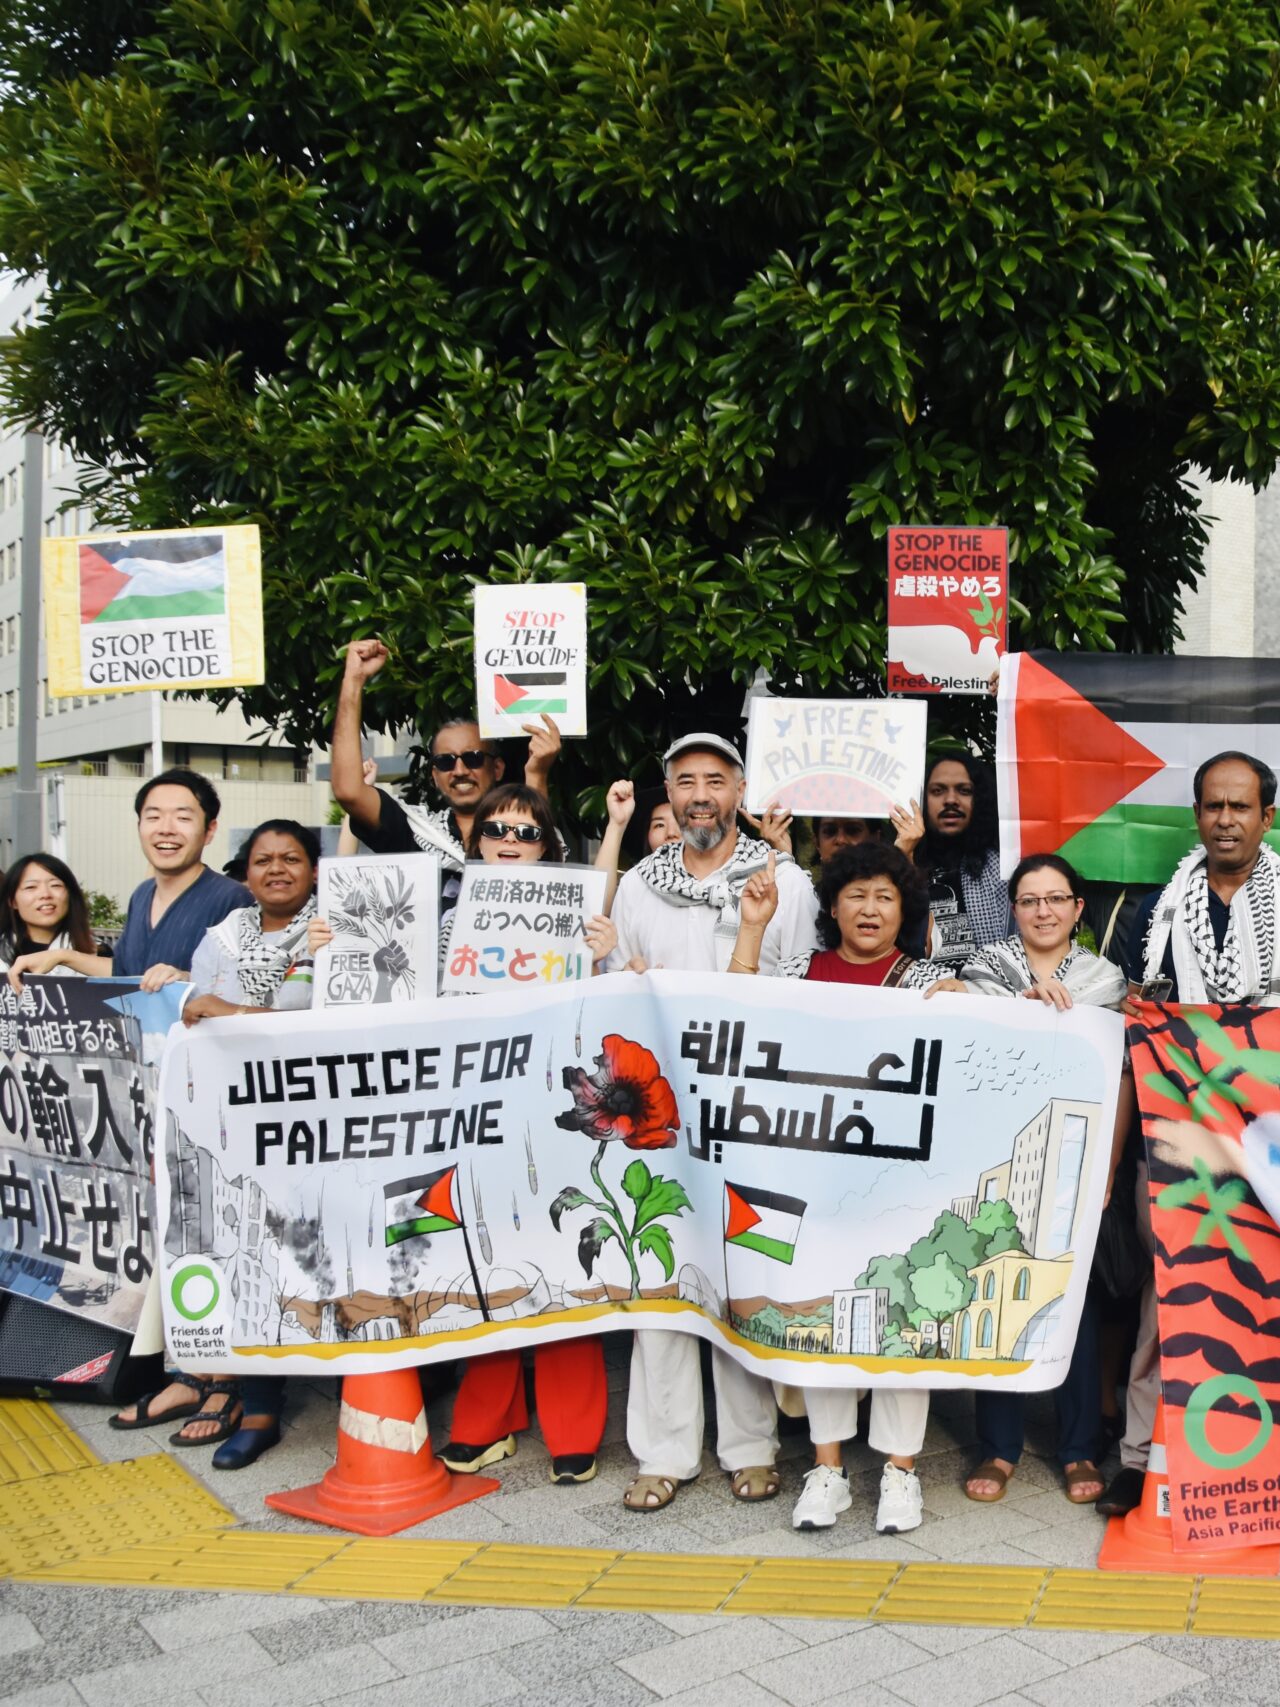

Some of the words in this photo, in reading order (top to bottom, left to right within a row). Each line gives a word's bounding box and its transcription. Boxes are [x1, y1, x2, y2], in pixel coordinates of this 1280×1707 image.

[895, 534, 944, 551] STOP
[949, 535, 982, 551] THE
[895, 554, 1001, 572] GENOCIDE
[895, 575, 1001, 597] 虐殺やめろ
[503, 611, 565, 628] STOP
[92, 633, 154, 658] STOP
[163, 629, 216, 652] THE
[510, 629, 557, 646] TEH
[90, 654, 221, 683] GENOCIDE
[485, 647, 578, 667] GENOCIDE
[892, 675, 928, 688] Free
[931, 676, 992, 690] Palestin
[803, 706, 878, 737] FREE
[764, 739, 907, 790] PALESTINE
[469, 878, 584, 908] 使用済み燃料
[473, 909, 588, 938] むつへの搬入
[330, 952, 371, 972] FREE
[450, 944, 582, 983] おことわり
[327, 972, 373, 1000] GAZA
[228, 1047, 442, 1105] JUSTICE
[453, 1033, 534, 1088] FOR
[681, 1020, 942, 1096] العدالة
[256, 1101, 504, 1166] PALESTINE
[686, 1084, 934, 1163] لفلسطين
[0, 1159, 153, 1283] 中止せよ
[171, 1325, 210, 1336] Friends
[212, 1324, 224, 1335] of
[172, 1339, 191, 1348] the
[194, 1338, 225, 1348] Earth
[197, 1350, 228, 1358] Pacific
[1180, 1477, 1259, 1500] Friends
[1183, 1504, 1217, 1522] the
[1187, 1525, 1224, 1541] Asia
